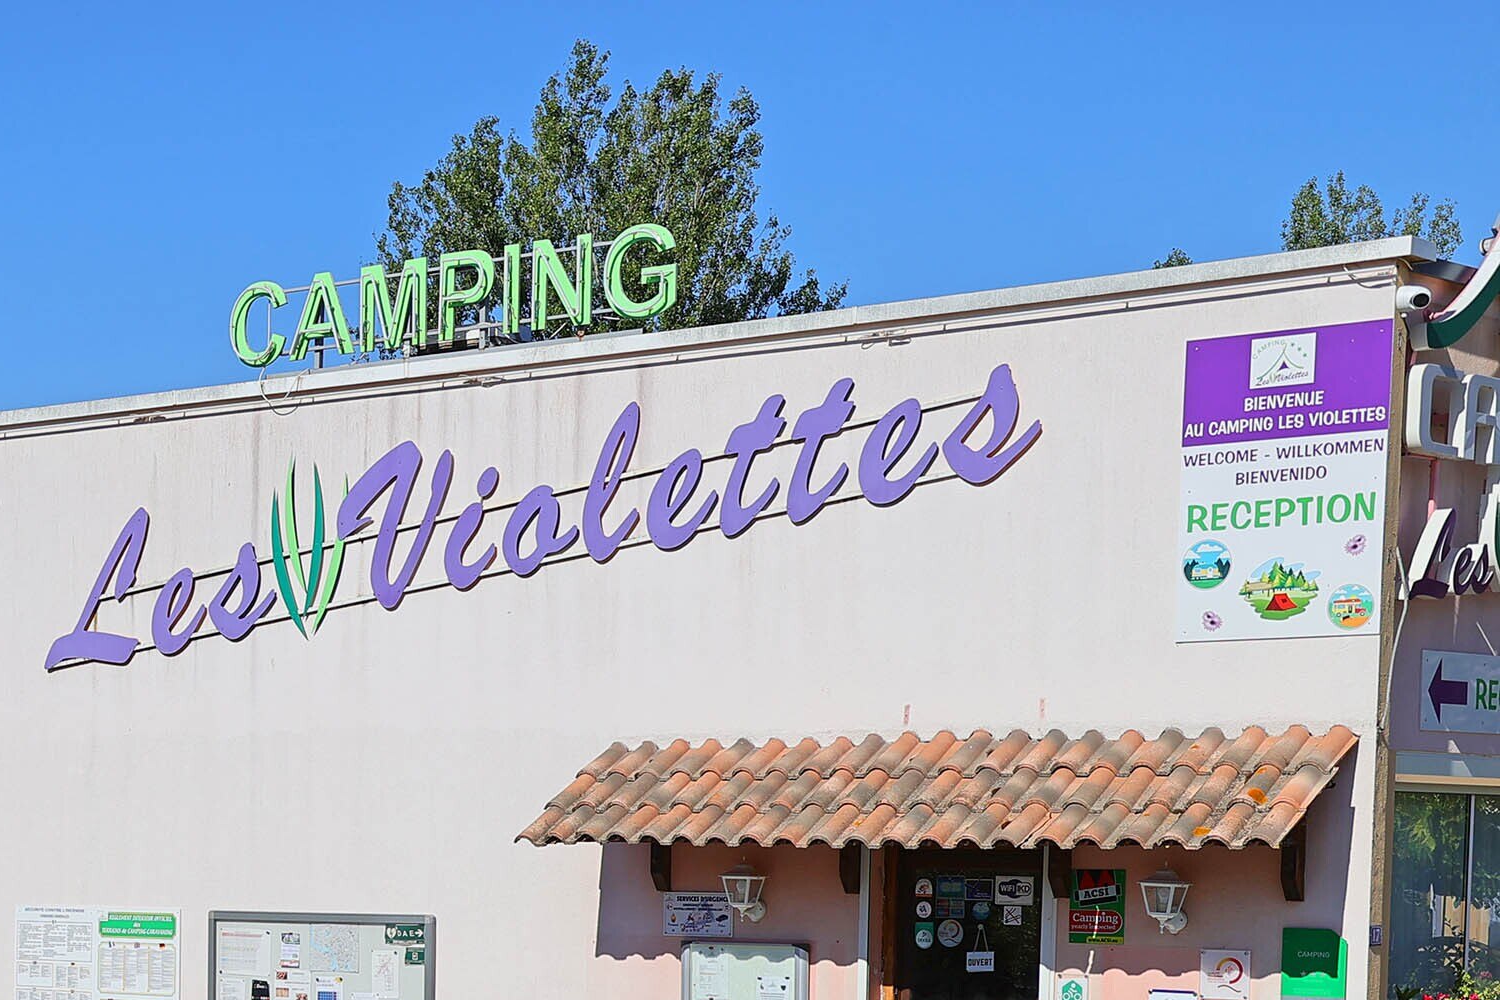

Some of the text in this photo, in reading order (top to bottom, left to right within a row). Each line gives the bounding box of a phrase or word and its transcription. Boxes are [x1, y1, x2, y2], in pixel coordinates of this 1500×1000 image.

[230, 223, 679, 368] CAMPING
[1244, 390, 1325, 412] BIENVENUE
[1184, 406, 1386, 438] AU CAMPING LES VIOLETTES
[1184, 449, 1258, 467] WELCOME
[1276, 438, 1384, 460] WILLKOMMEN
[1235, 465, 1327, 486] BIENVENIDO
[45, 363, 1041, 673] Les Violettes
[1187, 492, 1376, 533] RECEPTION
[1398, 507, 1493, 601] Les
[1476, 678, 1500, 710] RE
[1084, 887, 1109, 898] ACSI
[1072, 911, 1119, 925] Camping
[967, 958, 993, 967] OUVERT
[1297, 951, 1331, 959] CAMPING
